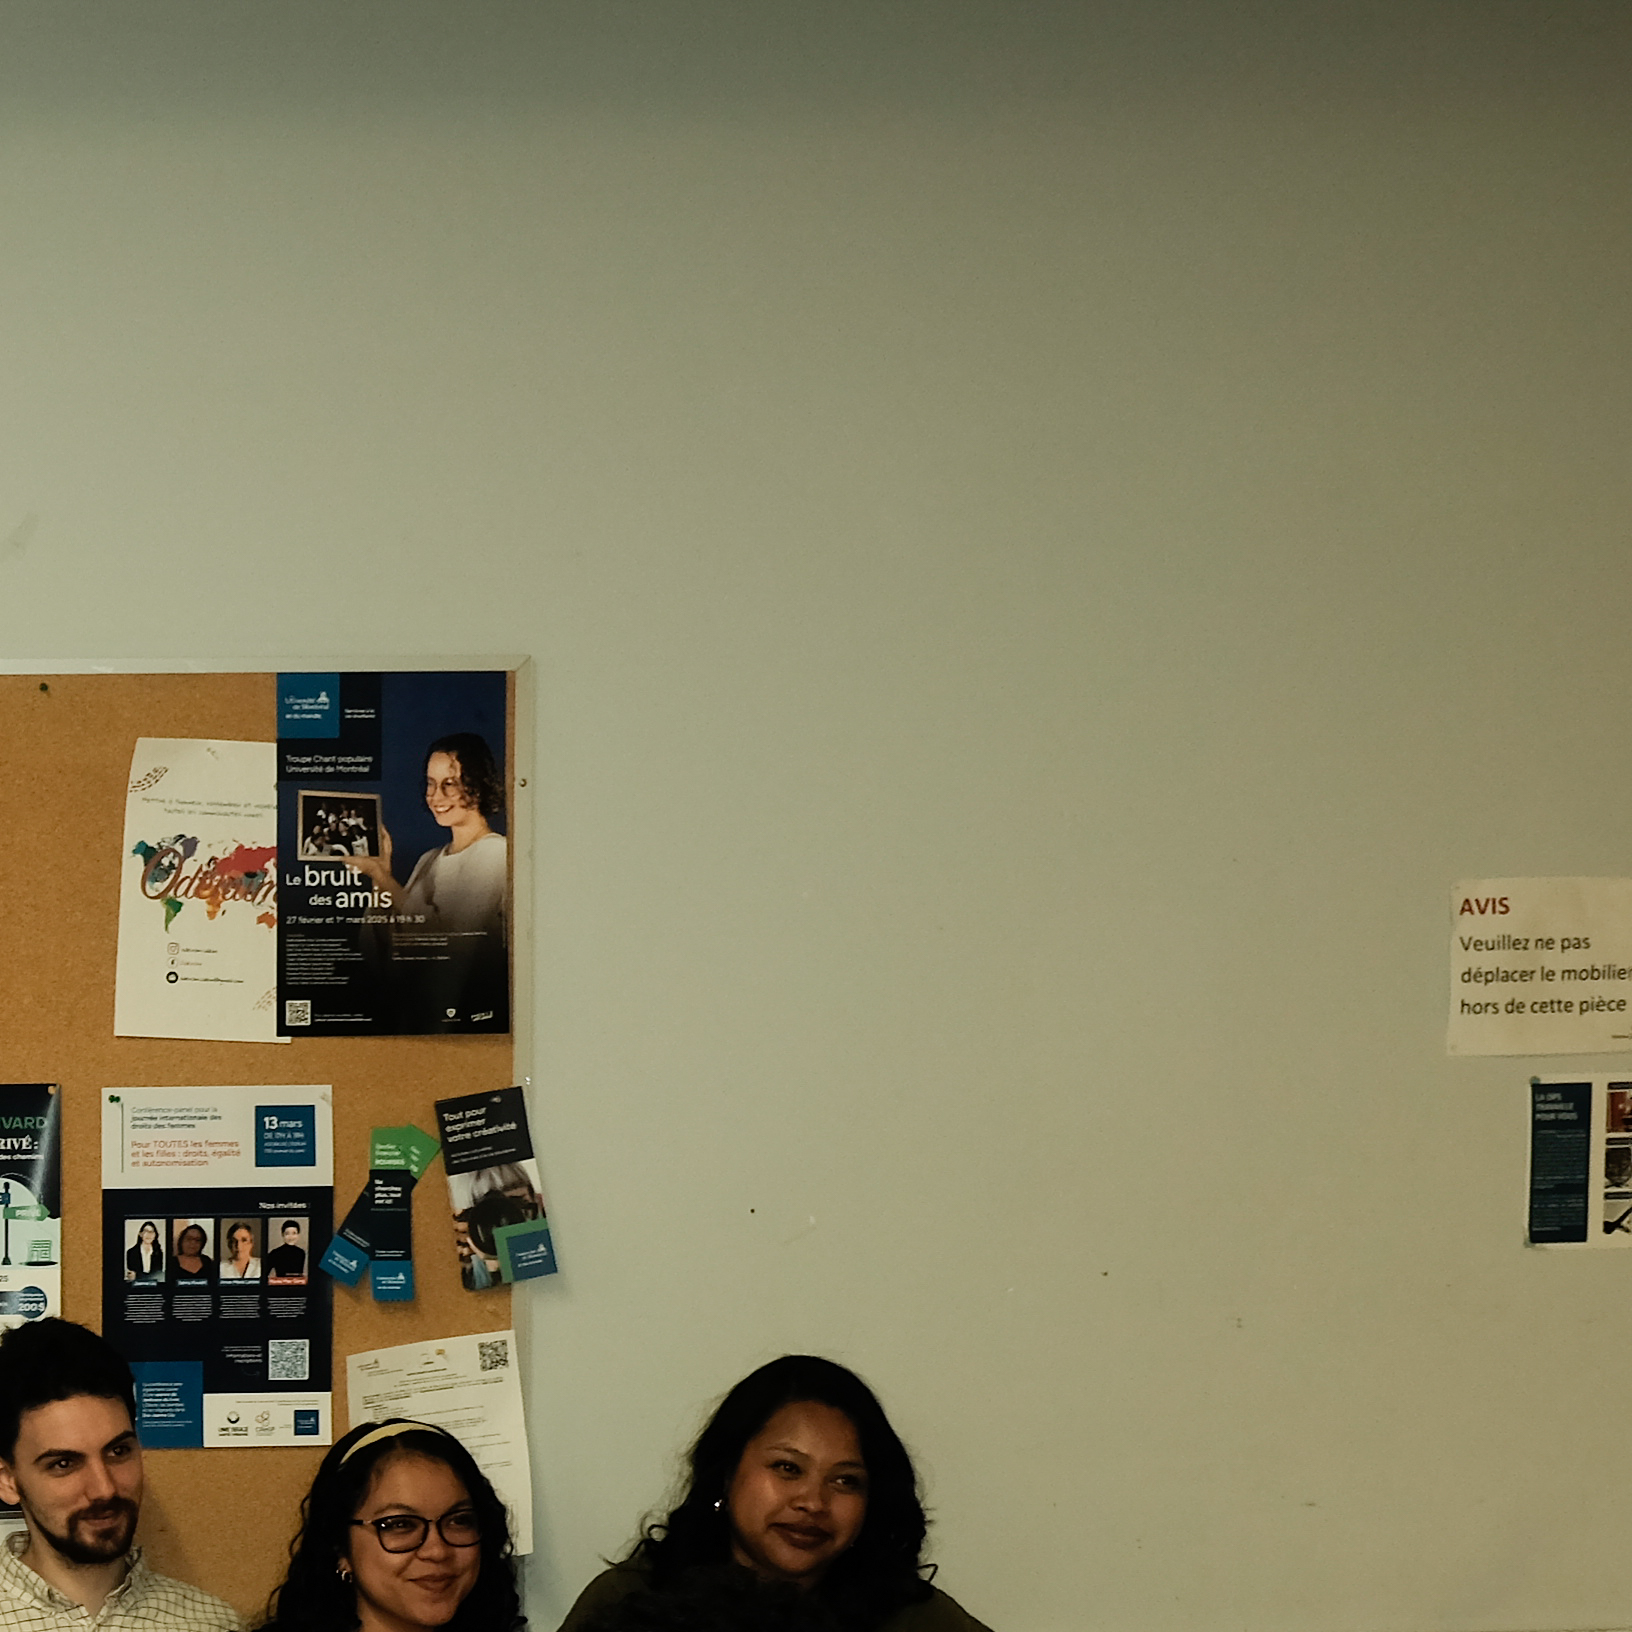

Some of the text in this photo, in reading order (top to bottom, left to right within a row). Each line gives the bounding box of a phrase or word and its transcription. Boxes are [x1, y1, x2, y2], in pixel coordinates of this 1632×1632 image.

[286, 865, 362, 887] Le bruit
[309, 885, 392, 908] des amis
[1459, 897, 1510, 916] AVIS
[1459, 935, 1591, 953] Veuillez ne pas
[1461, 967, 1536, 986] déplacer
[1541, 966, 1555, 981] le
[1460, 996, 1627, 1015] hors de cette pièce
[264, 1117, 302, 1129] 13 mars
